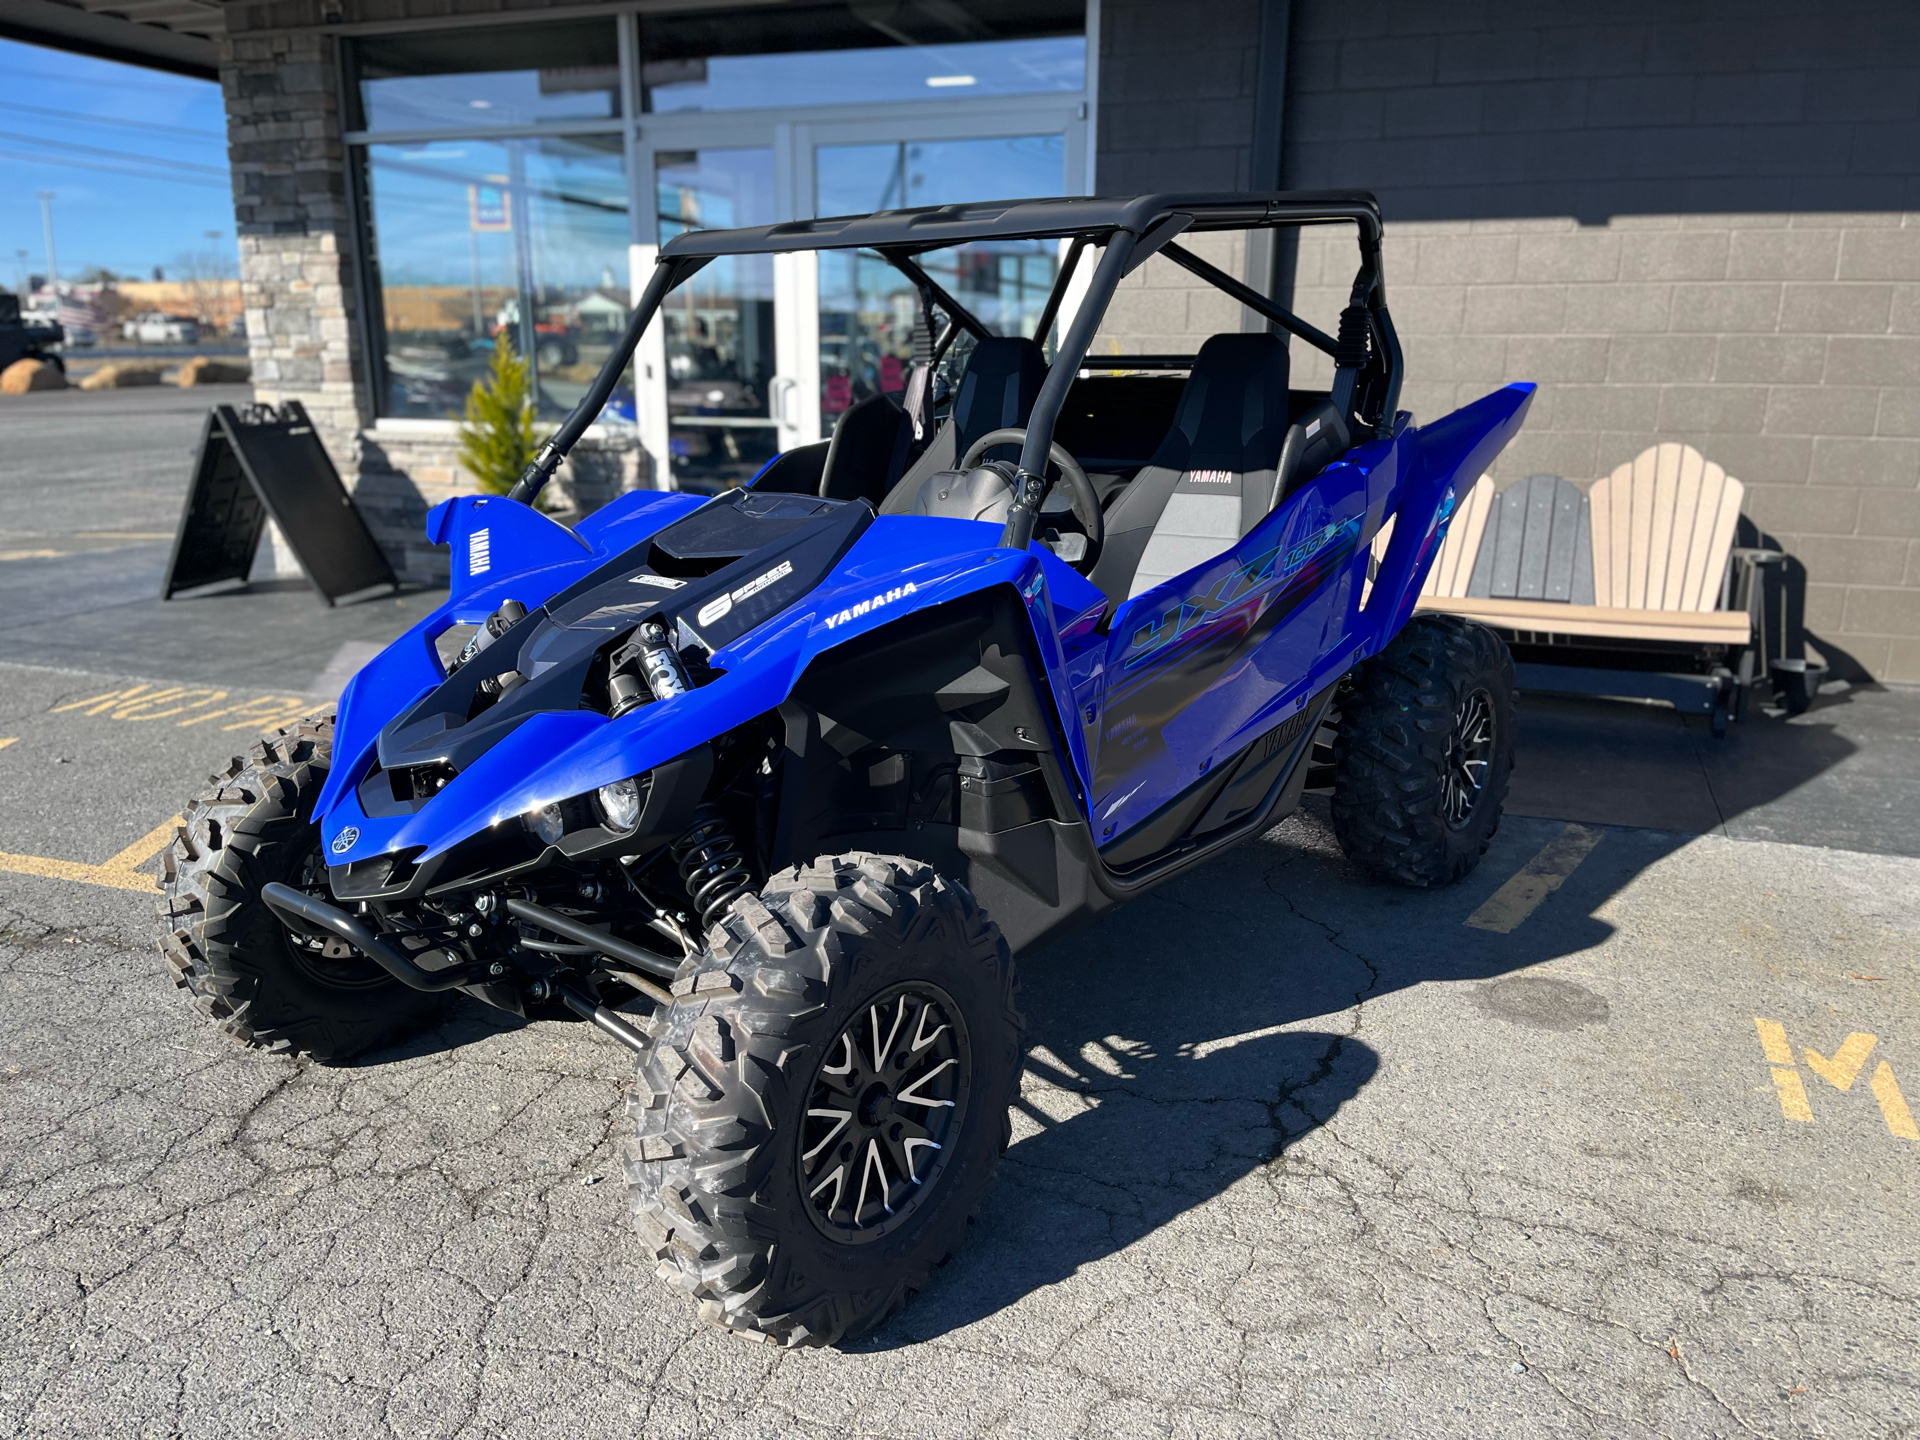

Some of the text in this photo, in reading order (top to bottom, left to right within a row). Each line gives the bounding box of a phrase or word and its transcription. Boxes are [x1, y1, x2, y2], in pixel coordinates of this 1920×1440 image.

[1189, 469, 1232, 484] YAMAHA
[469, 527, 491, 577] YAMAHA
[697, 592, 733, 627] 6
[731, 560, 791, 602] SPEED
[824, 581, 918, 630] YAMAHA
[645, 650, 686, 700] FOX
[1104, 713, 1137, 743] YAMAHA
[1263, 704, 1313, 759] YAMAHA
